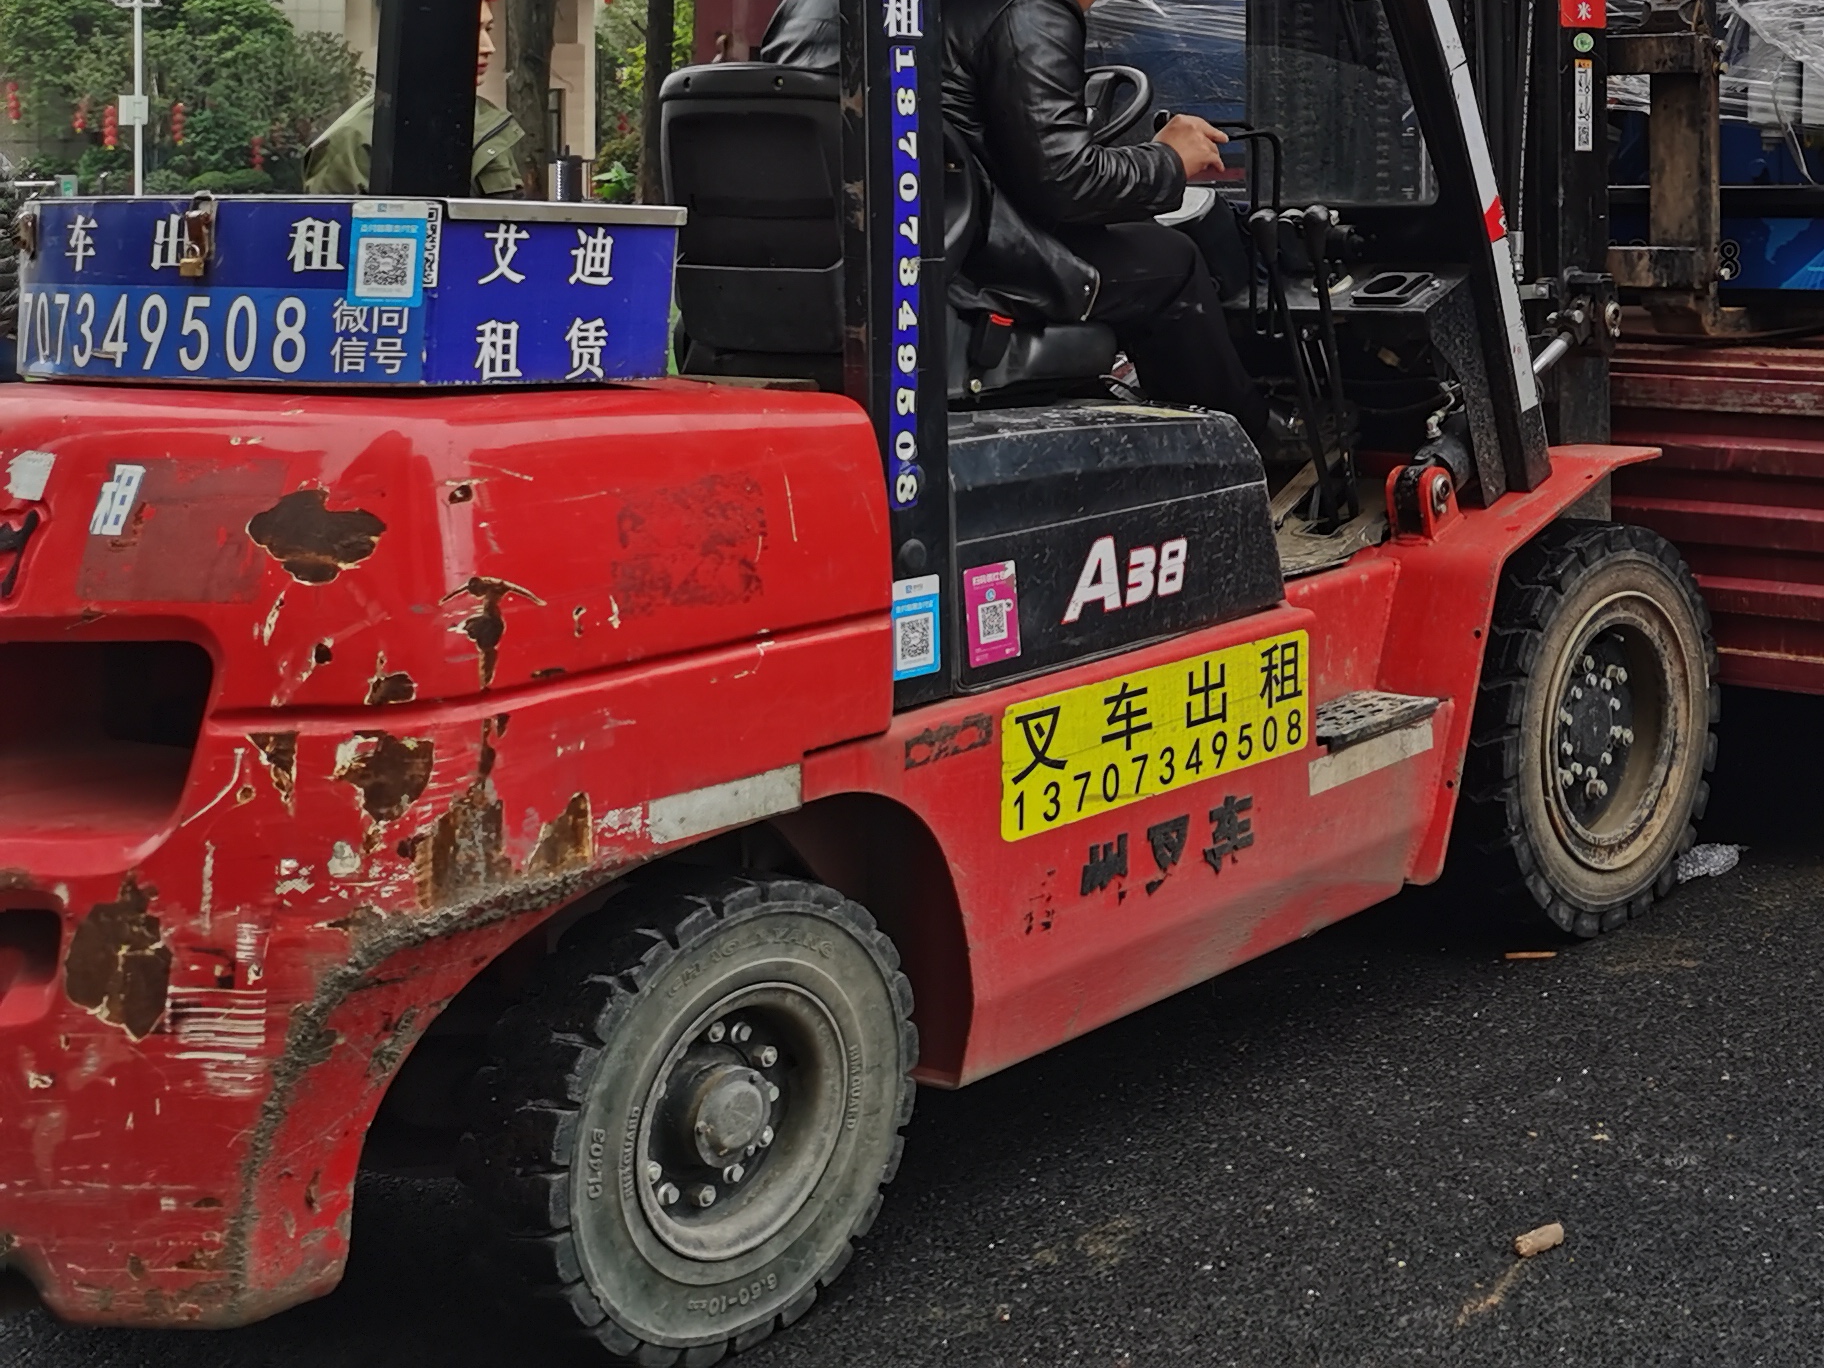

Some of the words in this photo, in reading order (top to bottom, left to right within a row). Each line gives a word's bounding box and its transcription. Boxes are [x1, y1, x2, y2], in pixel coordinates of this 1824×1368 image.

[478, 223, 614, 285] 艾迪
[895, 47, 919, 504] 13707349508
[474, 317, 609, 382] 租赁
[1060, 534, 1188, 625] A38
[1011, 640, 1303, 786] 叉车出租
[1013, 708, 1303, 832] 13707349508
